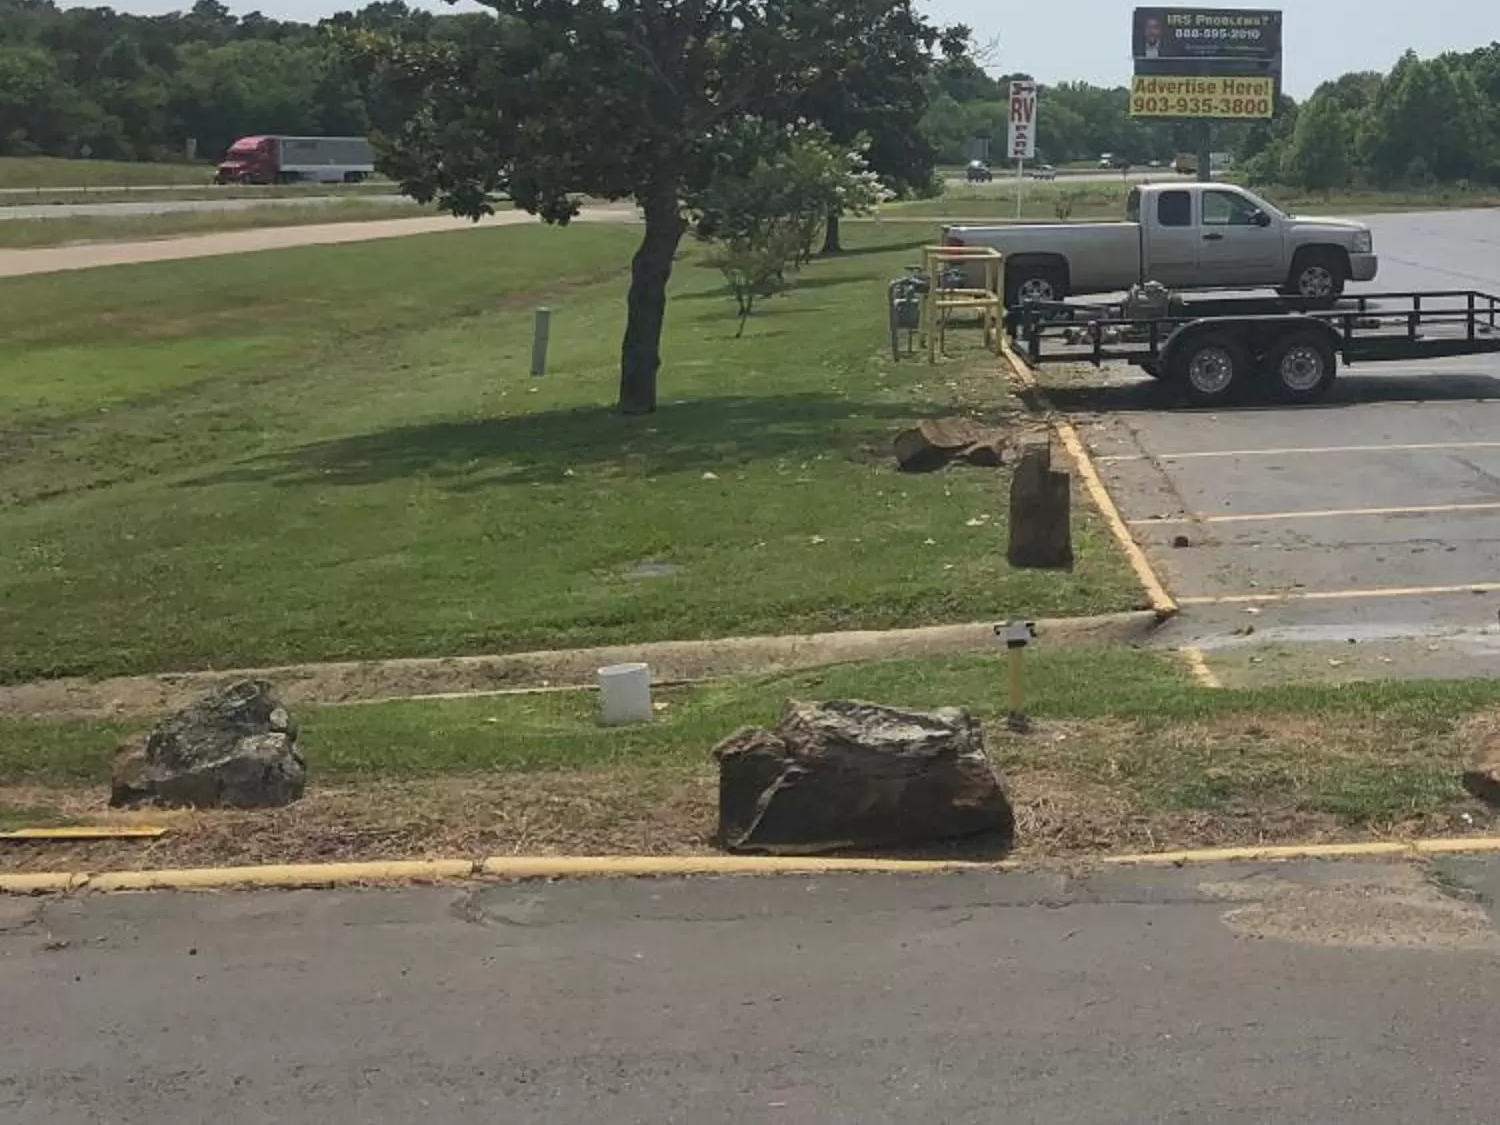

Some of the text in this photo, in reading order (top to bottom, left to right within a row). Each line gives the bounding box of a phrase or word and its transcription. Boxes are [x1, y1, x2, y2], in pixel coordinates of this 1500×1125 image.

[1167, 14, 1192, 26] IRS
[1135, 79, 1269, 96] Advertise Here!
[1011, 97, 1035, 123] RV
[1134, 97, 1269, 114] 903-935-3800
[1014, 125, 1028, 156] PARK
